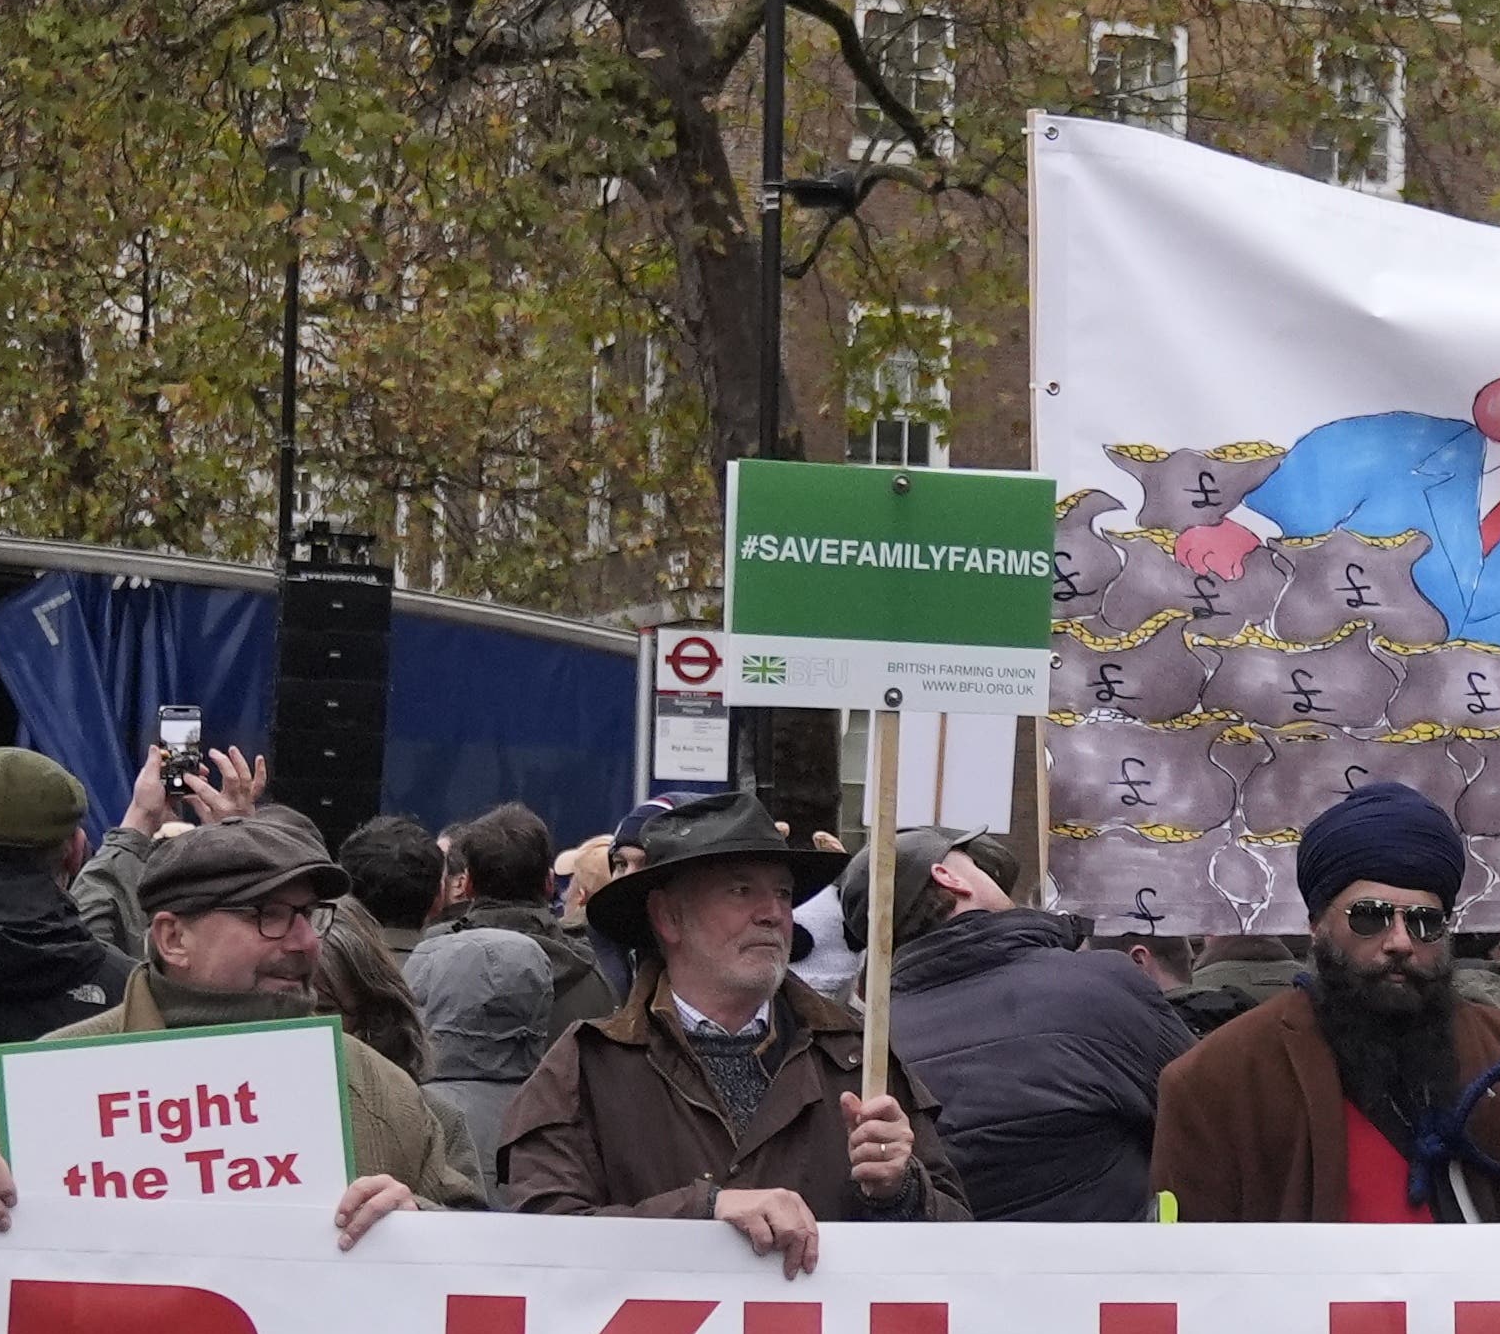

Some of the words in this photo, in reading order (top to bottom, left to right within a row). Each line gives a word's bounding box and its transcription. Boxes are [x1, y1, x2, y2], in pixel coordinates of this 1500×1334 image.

[741, 534, 1050, 577] #SAVEFAMILYFARMS
[789, 657, 849, 688] BFU
[887, 662, 936, 676] BRITISH
[939, 664, 994, 679] FARMING
[997, 667, 1036, 680] UNION
[922, 679, 1035, 697] WWW.BFU.ORG.UK
[97, 1081, 259, 1144] Fight
[63, 1161, 170, 1200] the
[184, 1149, 302, 1195] Tax
